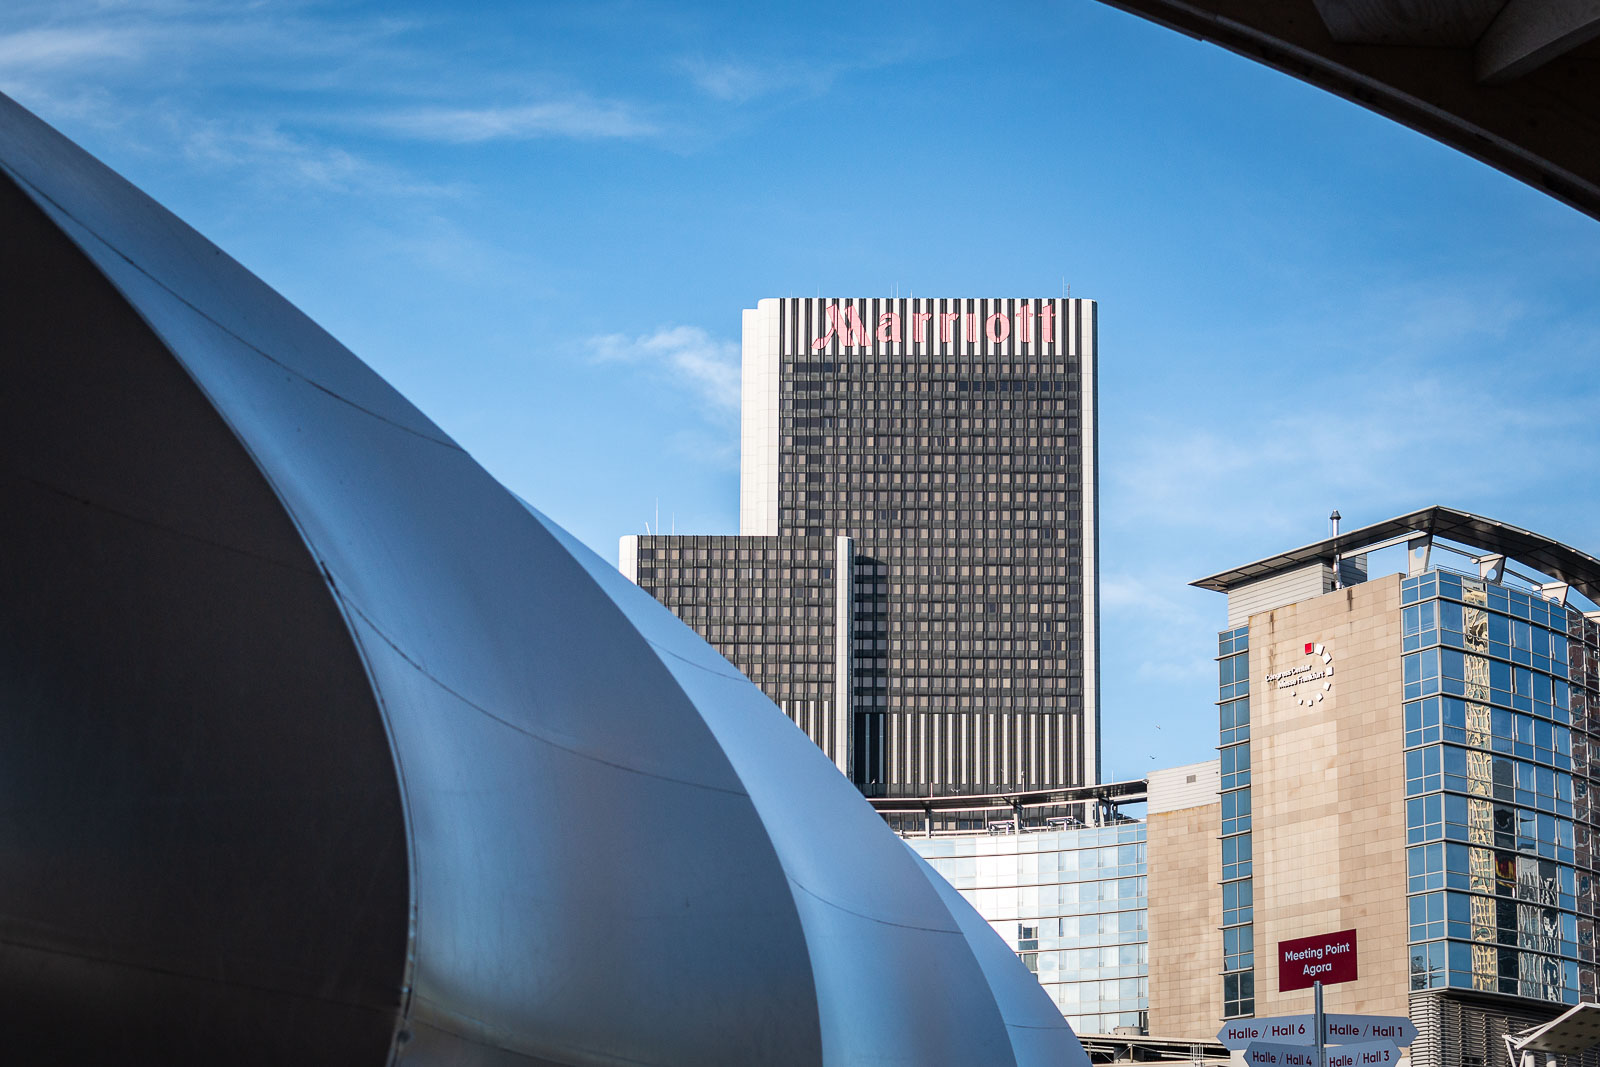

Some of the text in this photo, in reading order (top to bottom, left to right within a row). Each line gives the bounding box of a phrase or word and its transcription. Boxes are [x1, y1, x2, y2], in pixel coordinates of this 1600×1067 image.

[811, 303, 1056, 350] Marriott
[1285, 943, 1350, 962] Meeting Point
[1302, 963, 1332, 976] Agora
[1228, 1023, 1306, 1040] Halle / Hall 6
[1329, 1024, 1403, 1038] Halle / Hall 1
[1252, 1050, 1313, 1067] Halle / Hall 4
[1329, 1050, 1390, 1067] Halle / Hall 3
